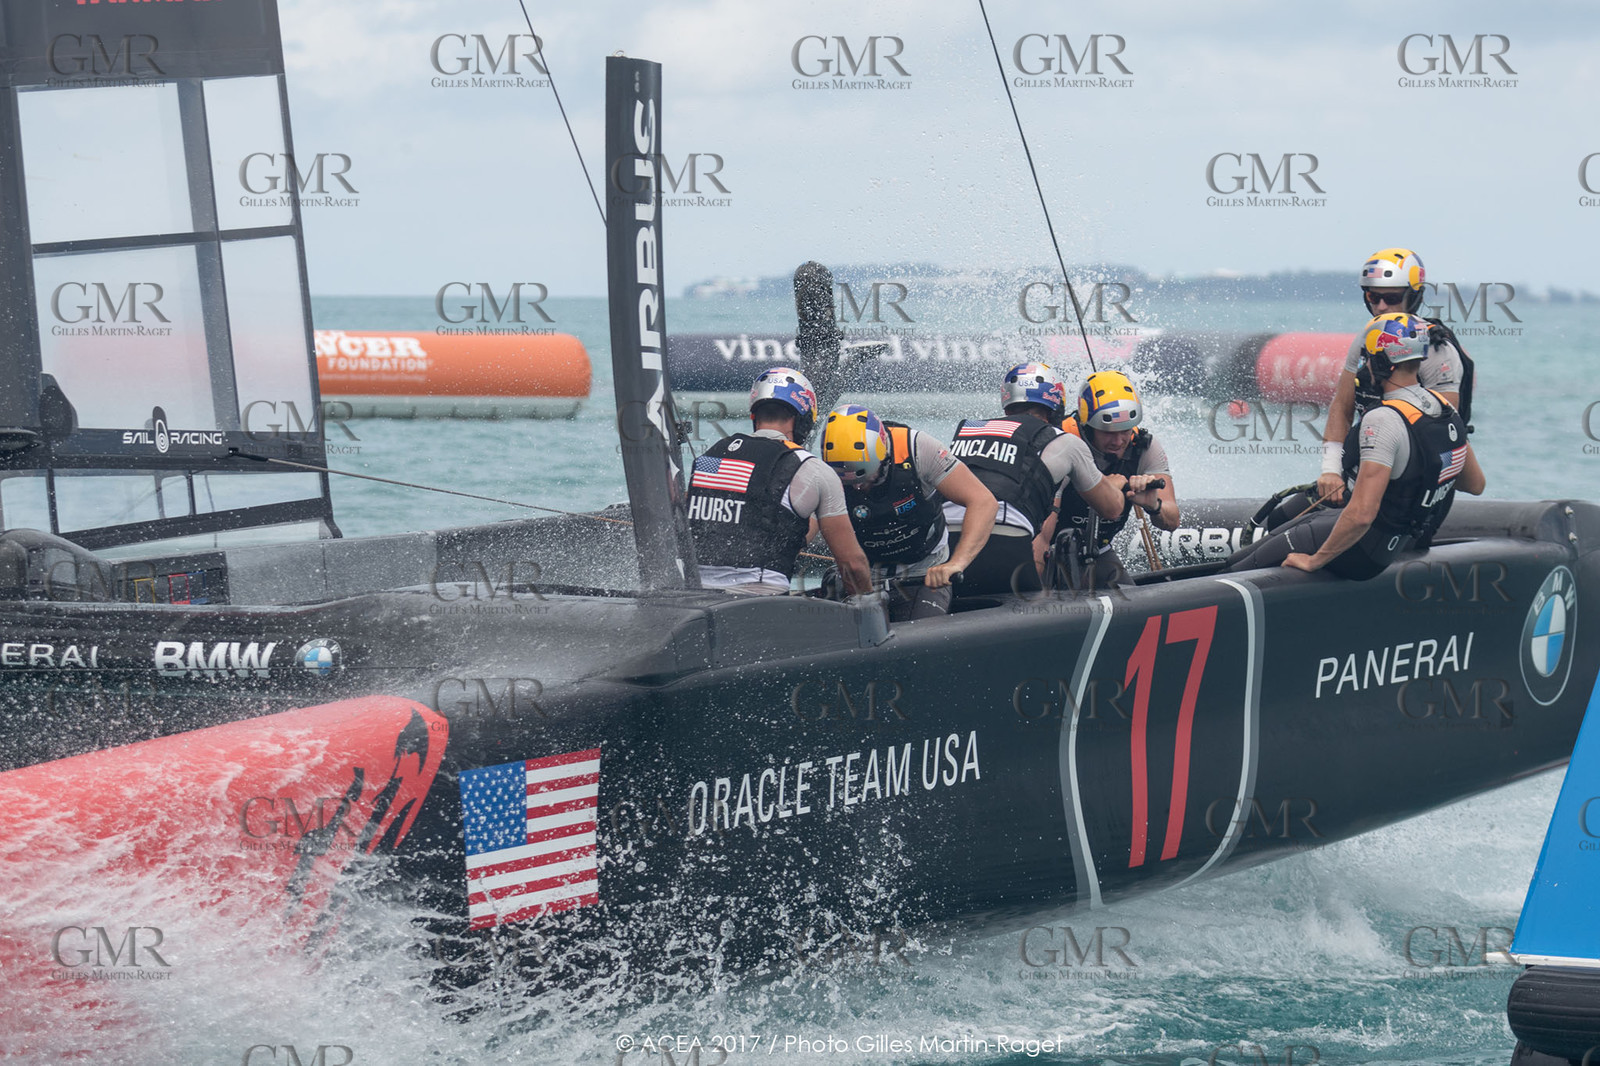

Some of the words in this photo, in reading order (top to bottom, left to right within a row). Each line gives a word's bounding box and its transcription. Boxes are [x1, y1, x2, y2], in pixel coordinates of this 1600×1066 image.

[633, 98, 671, 450] AIRBUS
[767, 377, 784, 385] USA
[123, 432, 154, 444] SAIL
[688, 495, 746, 524] HURST
[864, 528, 920, 548] ORACLE
[1127, 528, 1269, 560] AIRBU
[1, 642, 99, 668] ERAI
[155, 641, 278, 678] BMW
[1315, 632, 1474, 698] PANERAI
[1123, 605, 1218, 868] 17
[687, 761, 813, 837] ORACLE
[825, 742, 912, 809] TEAM
[921, 731, 981, 791] USA
